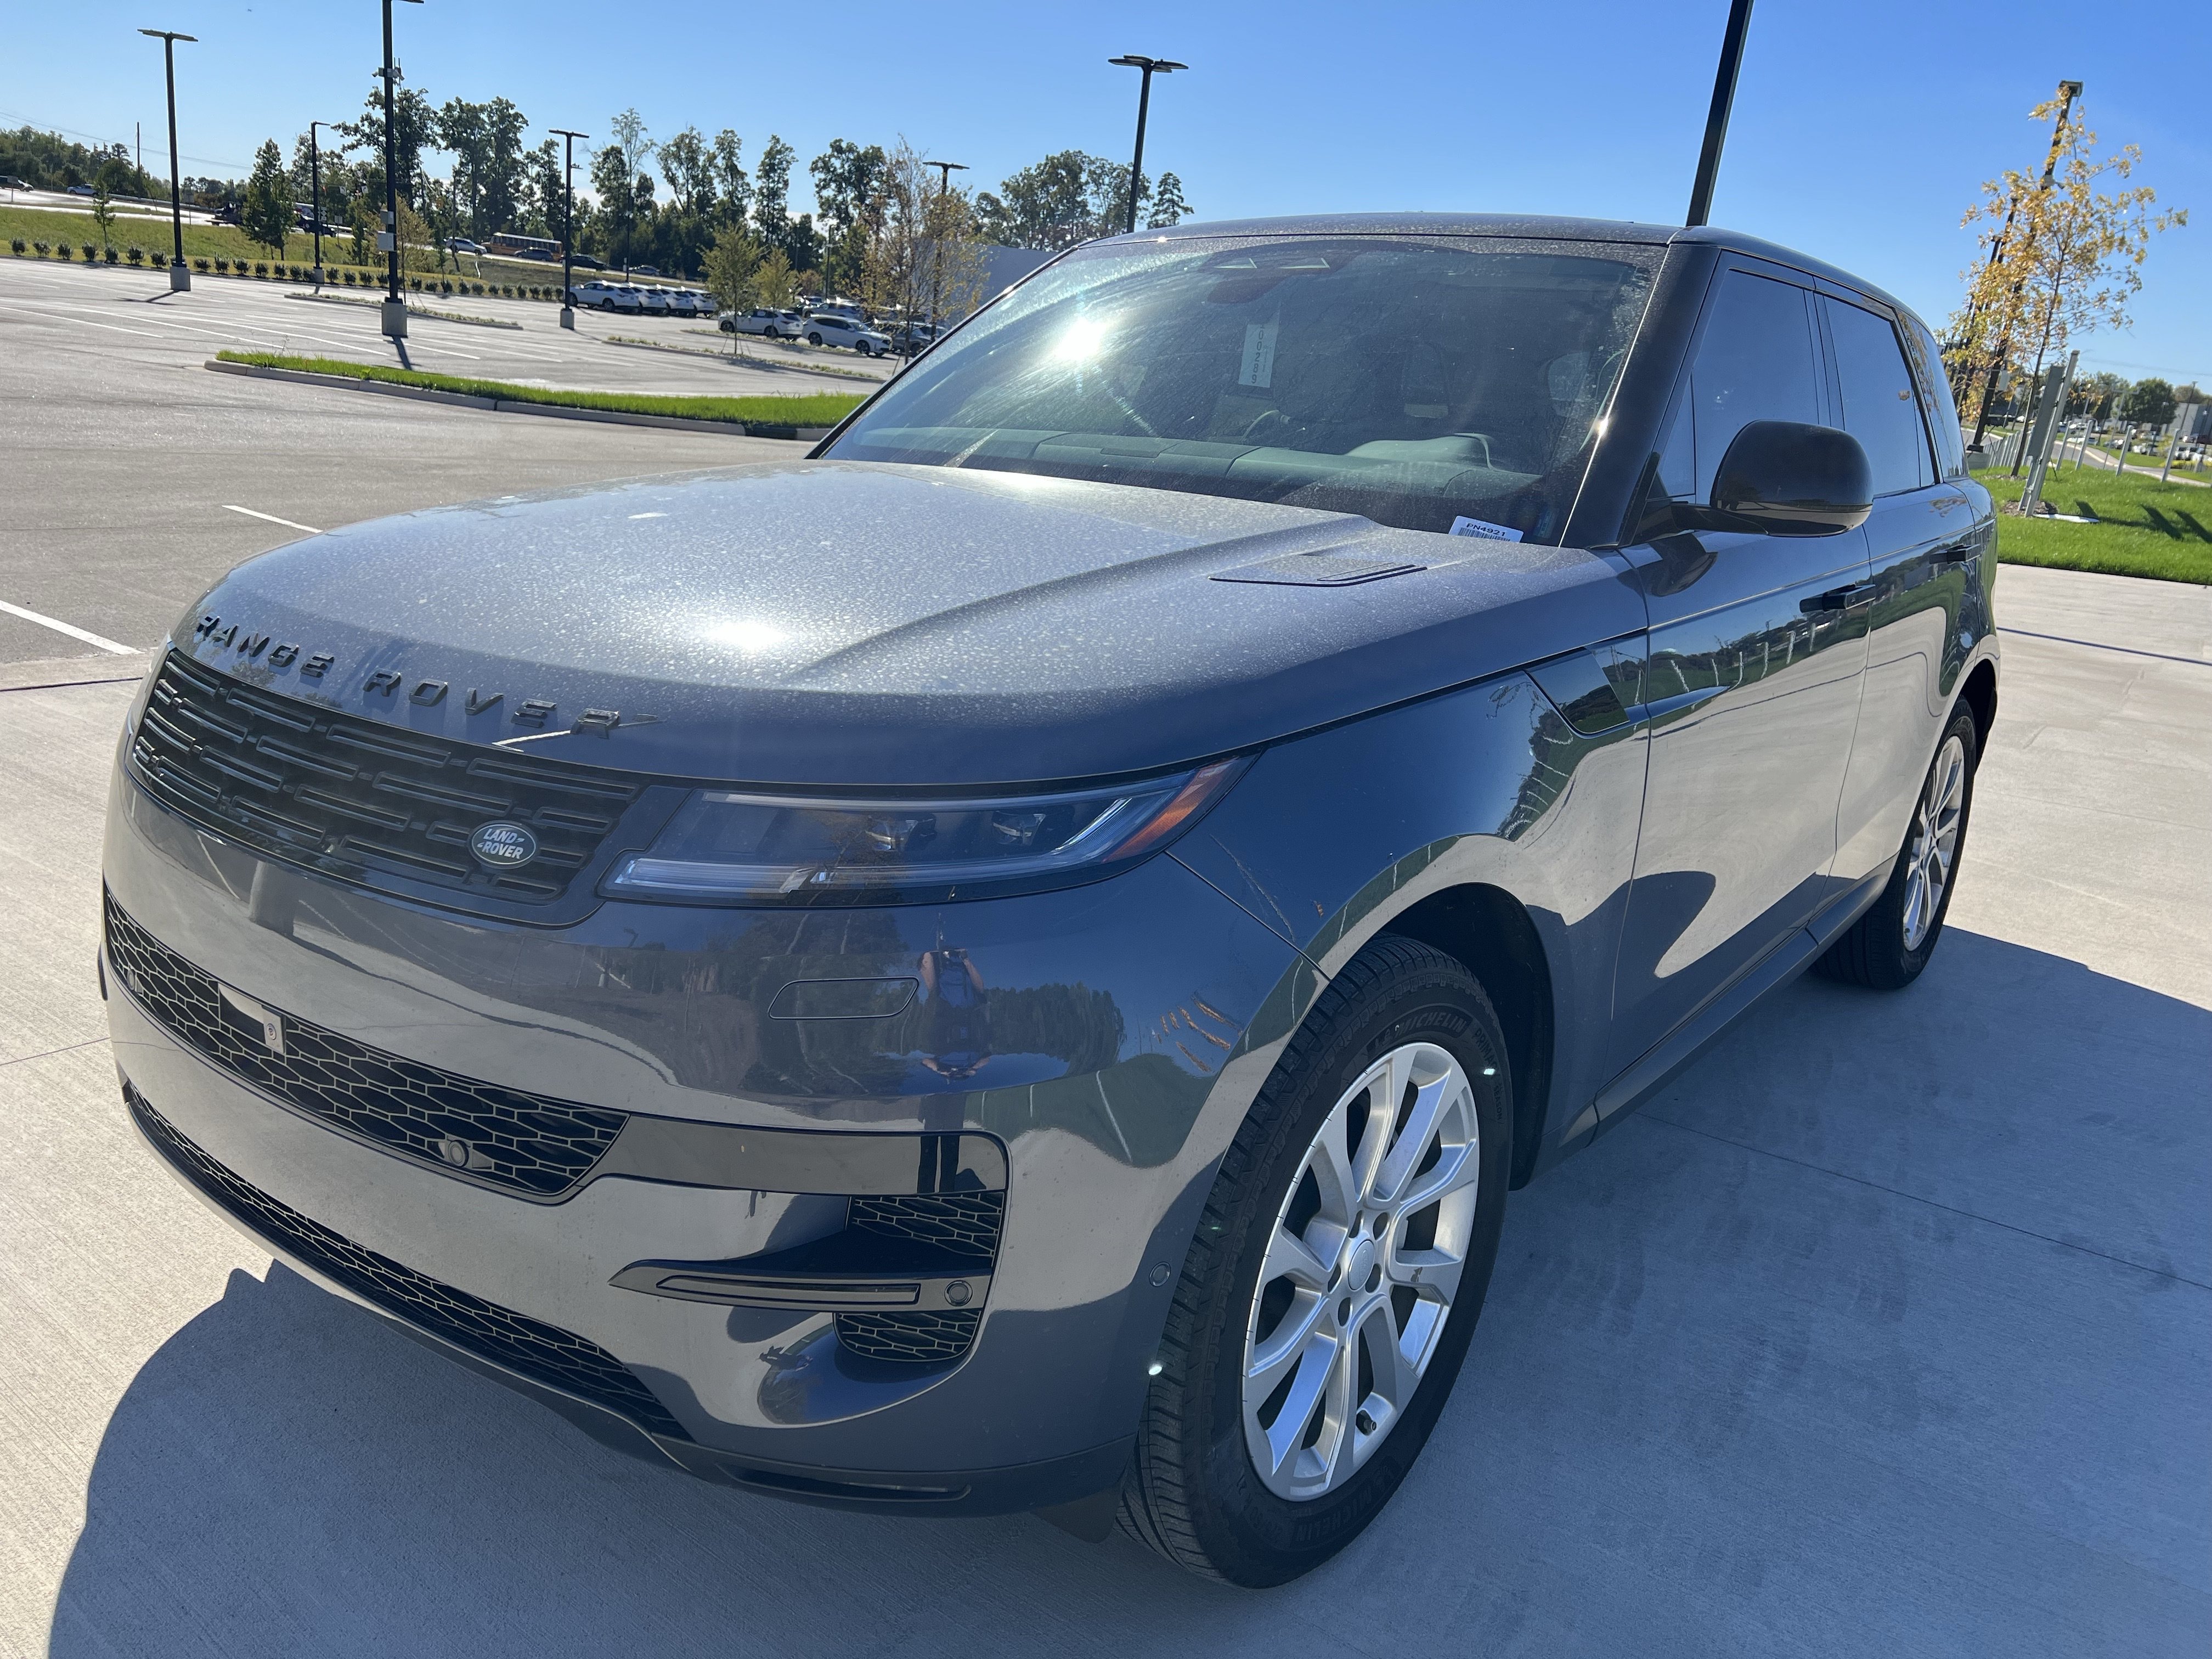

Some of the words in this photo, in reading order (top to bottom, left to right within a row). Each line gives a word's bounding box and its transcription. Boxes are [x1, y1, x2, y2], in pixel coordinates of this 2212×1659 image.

[1466, 523, 1505, 537] PN4921
[196, 614, 335, 678] RANGE
[363, 668, 620, 739] ROVER
[483, 828, 517, 843] LAND
[482, 841, 523, 859] ROVER
[1395, 1012, 1468, 1037] MICHELIN
[1471, 1027, 1500, 1075] PRIMAC
